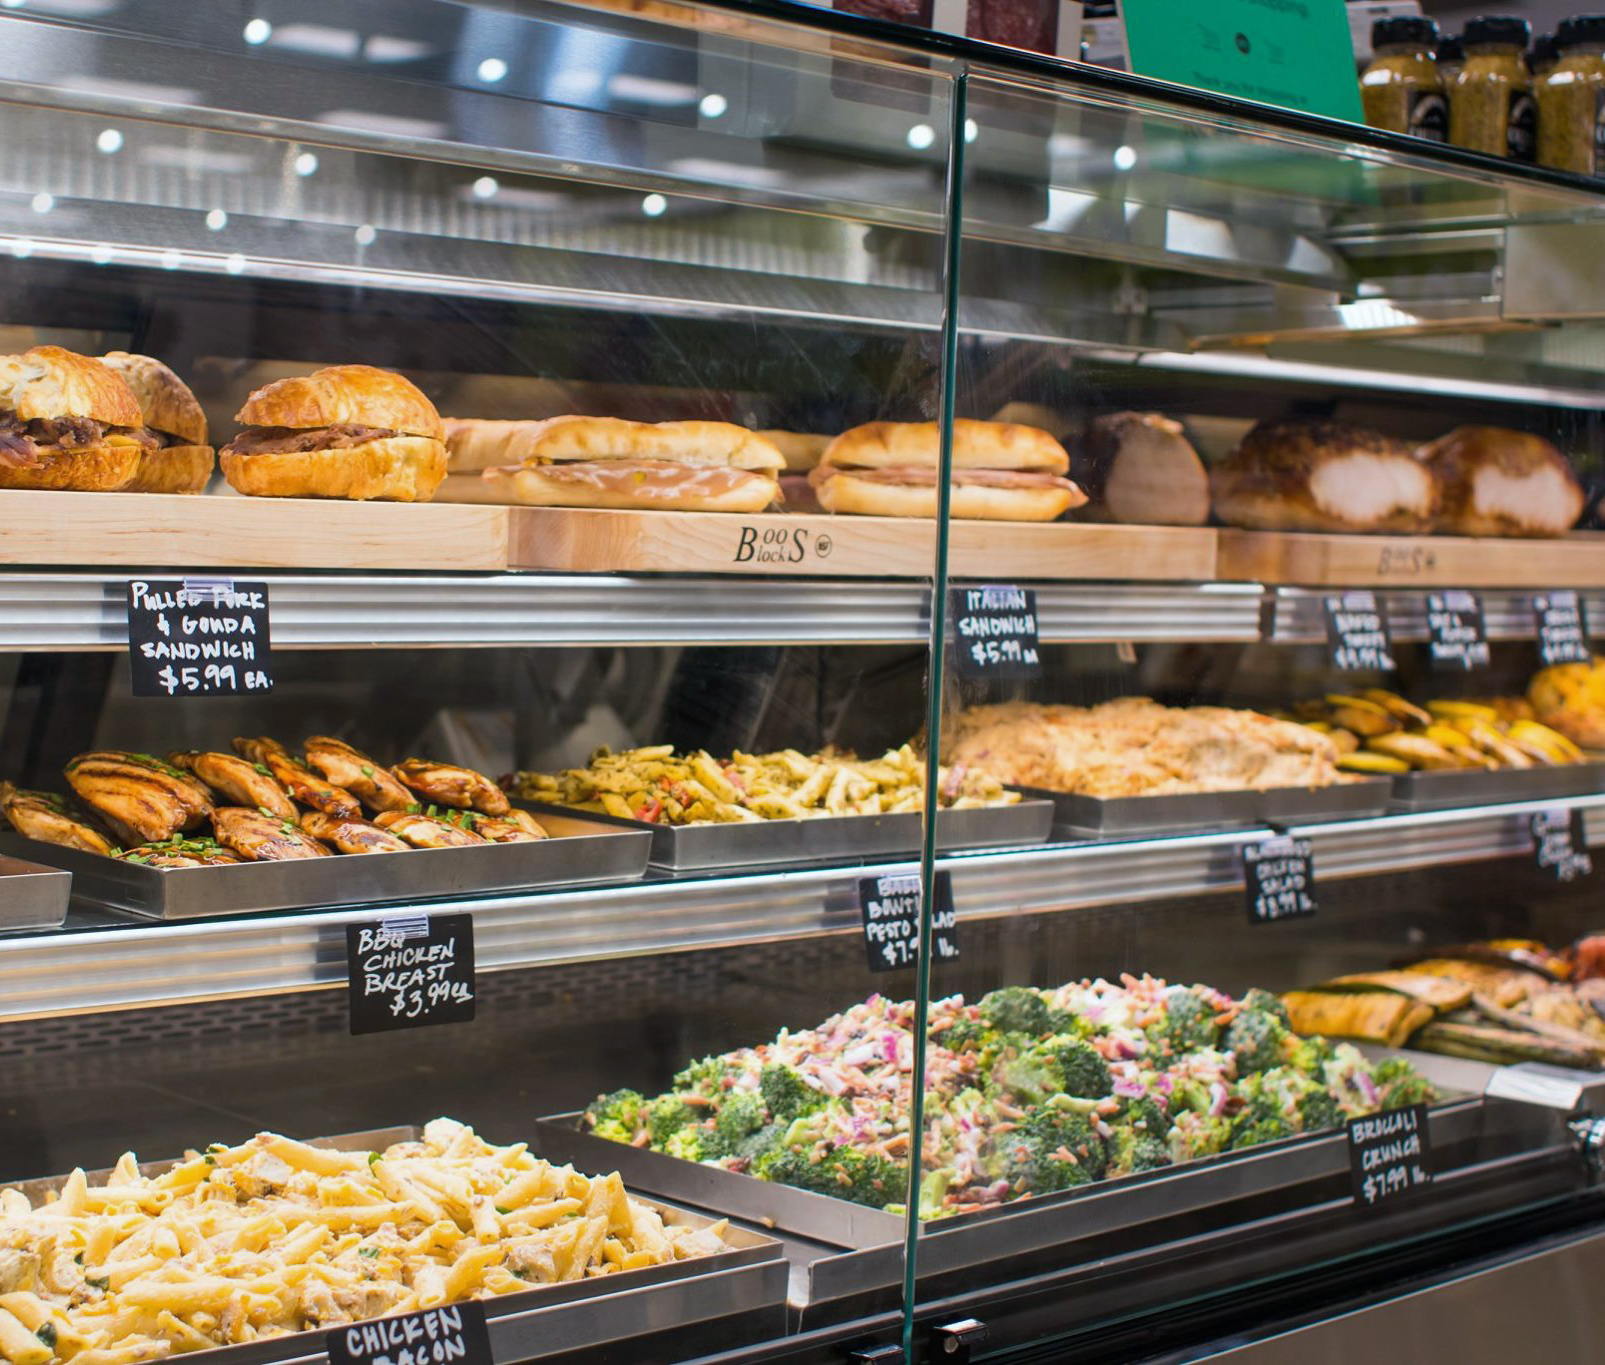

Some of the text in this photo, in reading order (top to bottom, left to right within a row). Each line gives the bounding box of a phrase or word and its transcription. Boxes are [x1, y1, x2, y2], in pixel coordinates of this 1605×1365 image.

[967, 590, 1027, 611] ITALIAN
[182, 614, 256, 635] GOUDA
[958, 614, 1036, 637] SANDWICH
[139, 639, 255, 660] SANDWICH
[971, 640, 1022, 666] $5.99
[158, 664, 236, 695] $5.99
[357, 928, 406, 955] BBQ
[866, 920, 911, 942] PESTO
[363, 937, 455, 972] CHICKEN
[364, 962, 455, 996] BREAST
[389, 980, 450, 1017] $3.99
[1363, 1165, 1408, 1203] $7.99
[346, 1305, 463, 1357] CHICKEN
